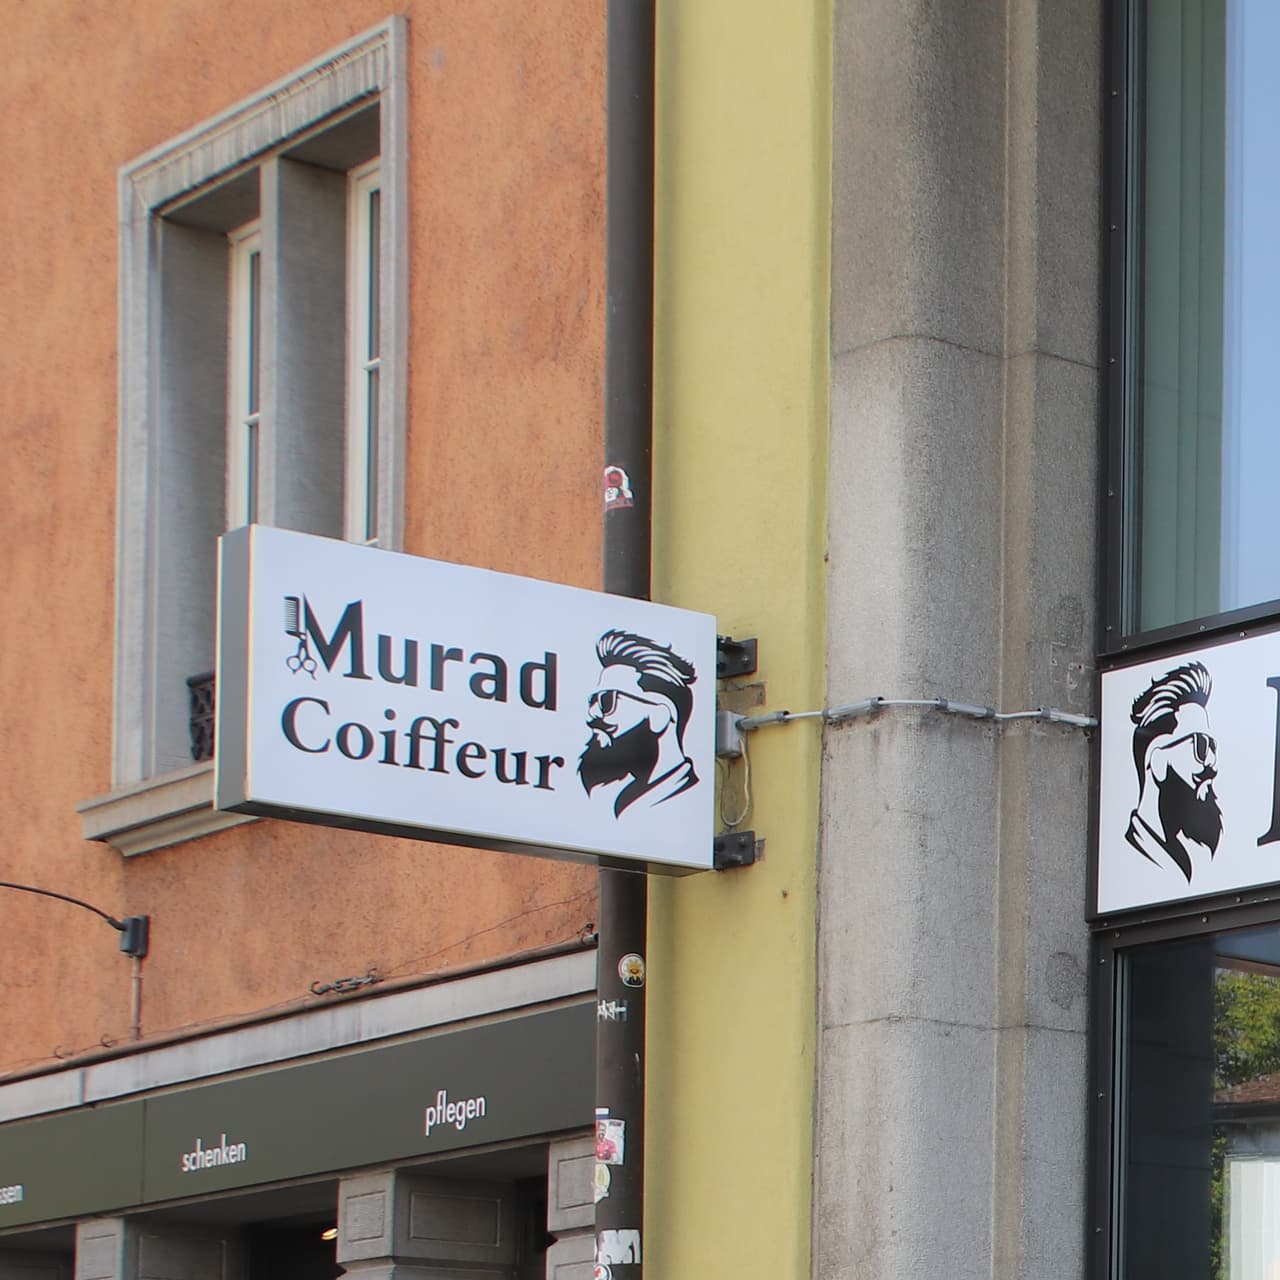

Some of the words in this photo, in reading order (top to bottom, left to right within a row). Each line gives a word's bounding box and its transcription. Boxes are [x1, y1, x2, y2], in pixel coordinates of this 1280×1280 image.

[302, 593, 557, 711] Murad
[281, 697, 565, 791] Coiffeur
[425, 1090, 486, 1135] pflegen
[181, 1134, 246, 1172] schenken
